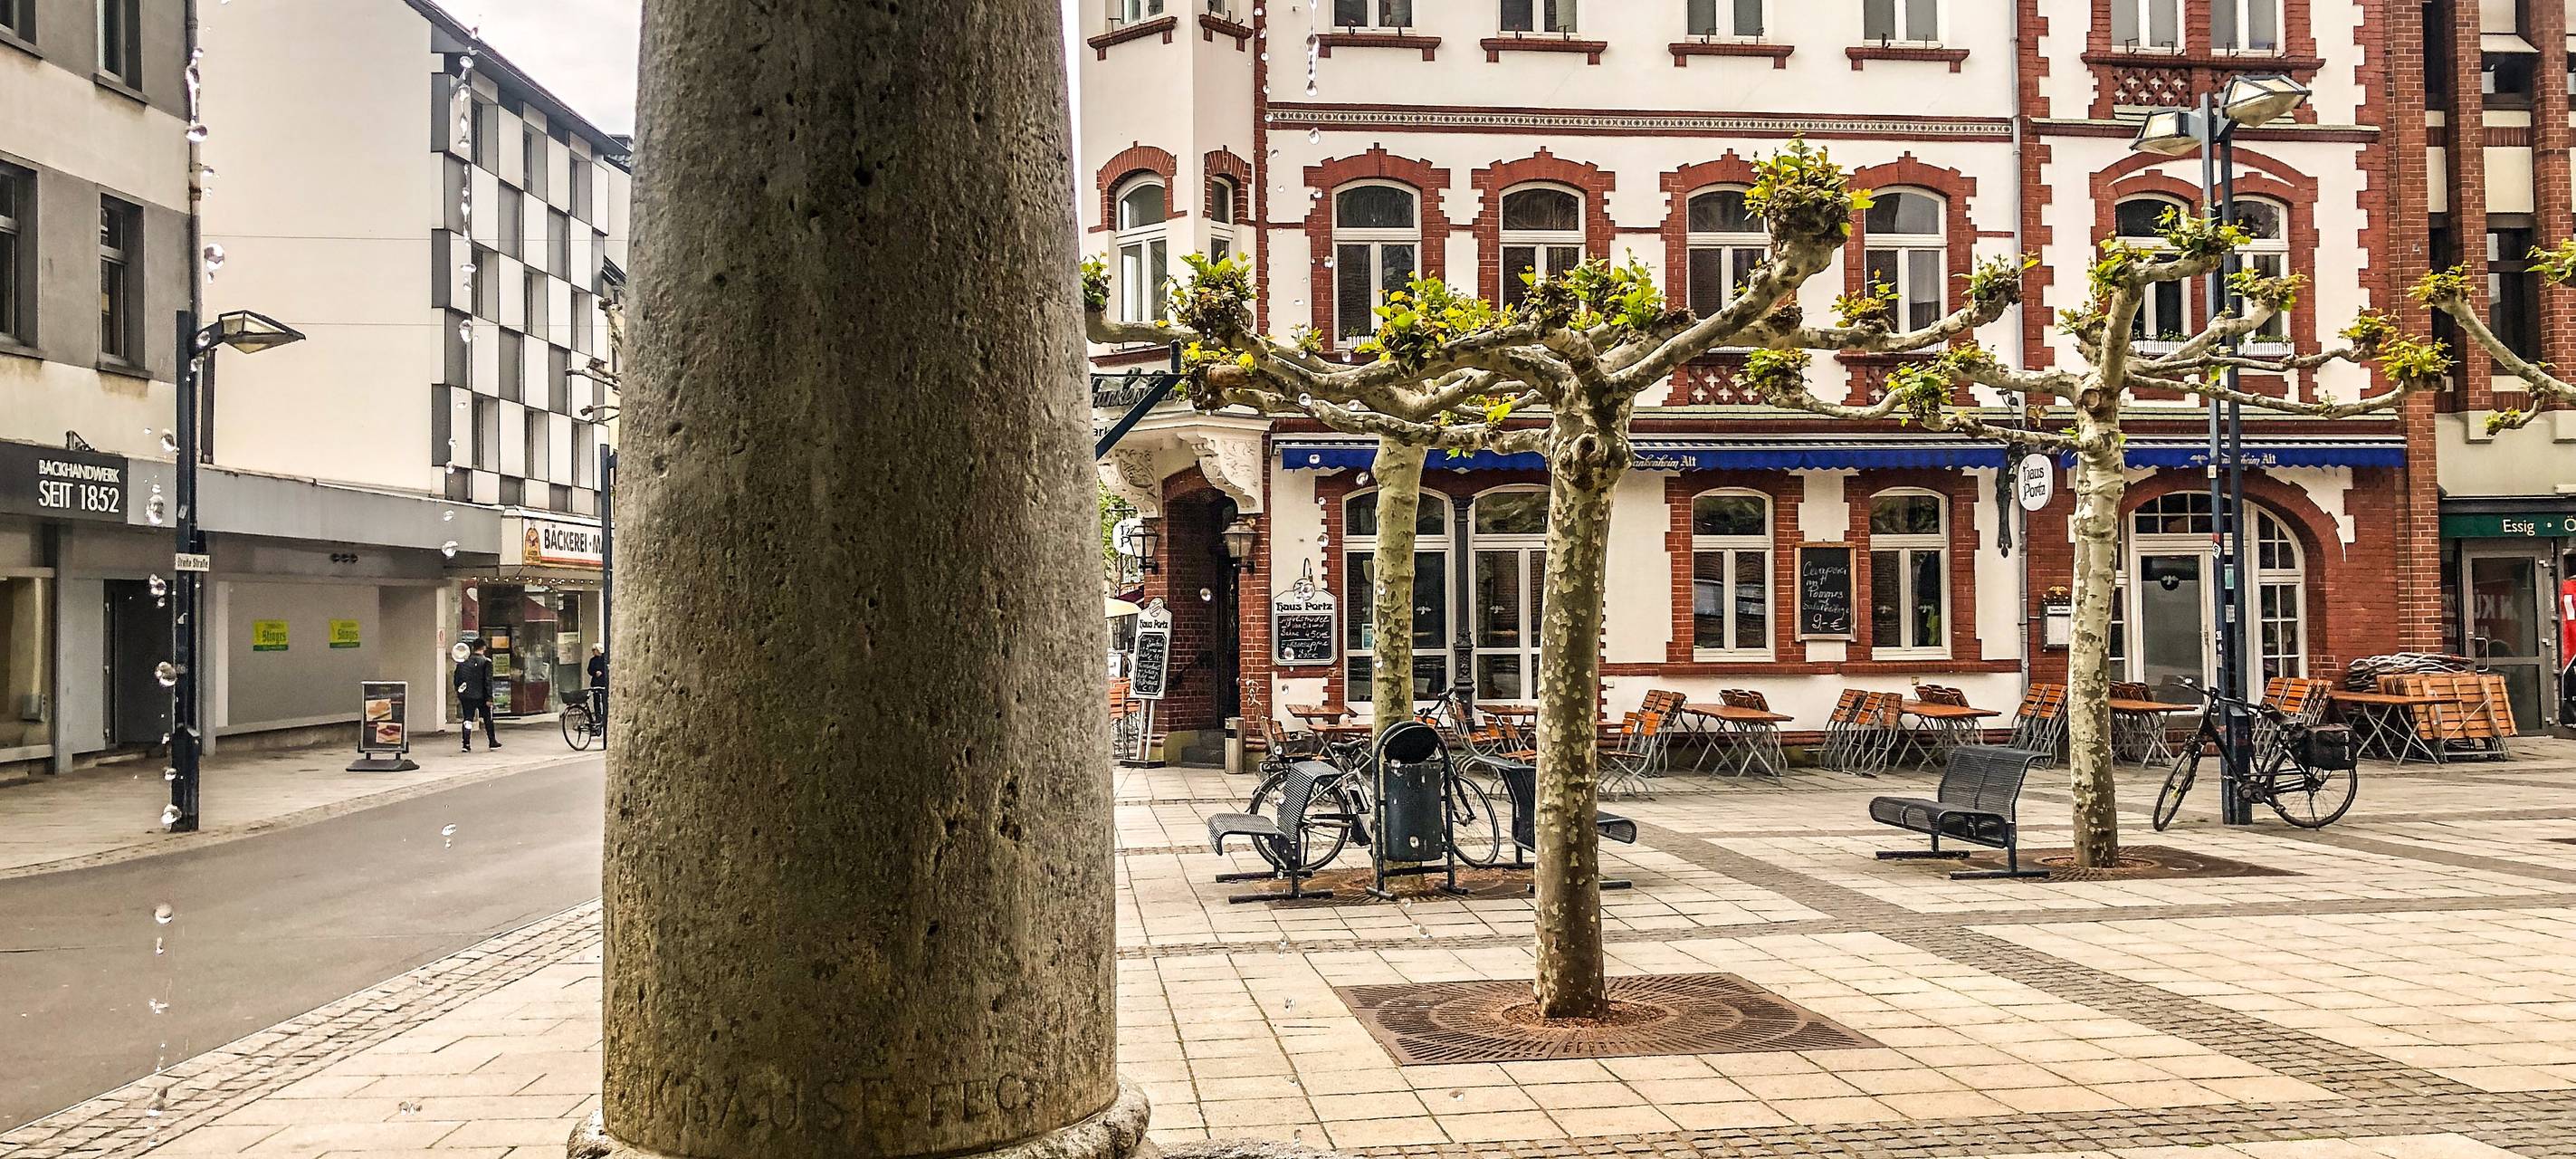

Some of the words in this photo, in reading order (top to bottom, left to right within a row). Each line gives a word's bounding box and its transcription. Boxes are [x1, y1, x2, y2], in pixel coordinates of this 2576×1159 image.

[1681, 455, 1696, 467] Alt
[2261, 453, 2276, 465] Alt
[38, 459, 120, 484] BACKHANDWERK
[38, 480, 74, 509] SEIT
[79, 484, 119, 513] 1852
[2022, 481, 2046, 502] Portz
[2503, 519, 2535, 536] Essig
[544, 524, 587, 553] BÄCKEREI
[1275, 602, 1302, 612] Haus
[1304, 601, 1333, 611] Portz
